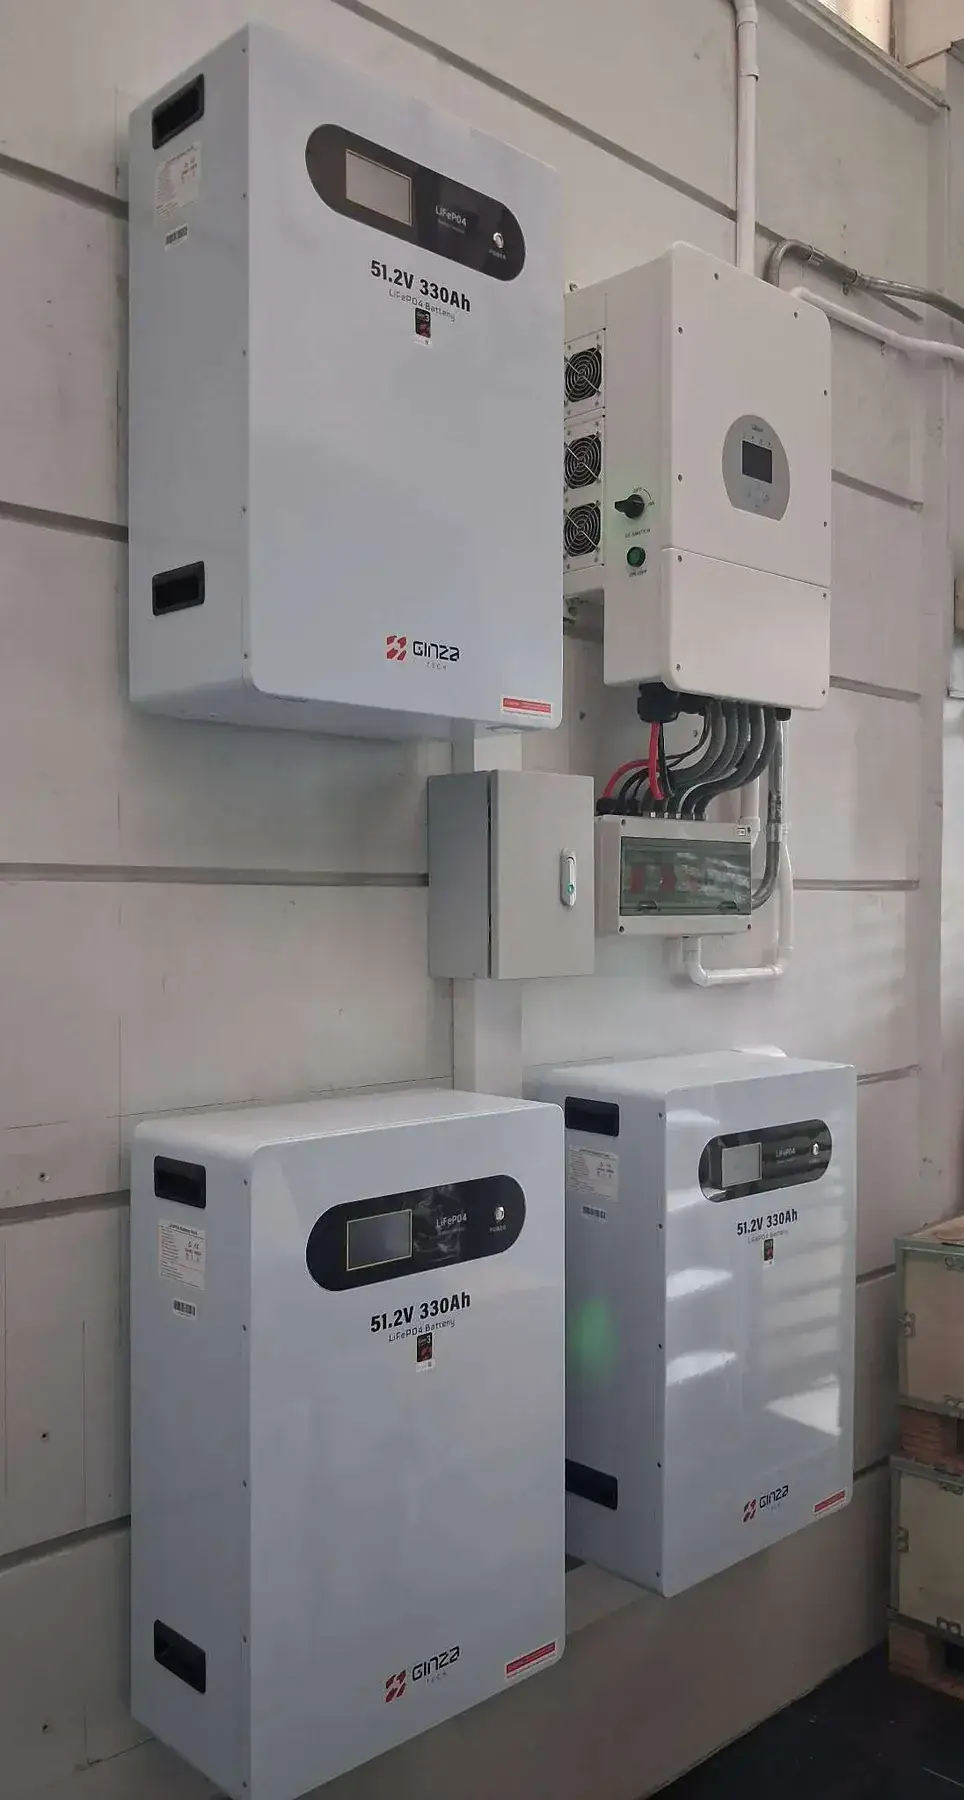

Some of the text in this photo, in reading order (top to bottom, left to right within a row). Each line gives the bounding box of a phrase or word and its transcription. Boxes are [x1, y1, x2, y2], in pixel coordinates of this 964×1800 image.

[435, 205, 467, 227] LiFePO4
[370, 259, 471, 313] 51.2V 330Ah
[425, 302, 456, 322] Battery
[436, 1213, 467, 1228] LiFePO4
[736, 1208, 798, 1236] 51.2V 330Ah
[370, 1291, 471, 1333] 51.2V 330Ah
[388, 1326, 423, 1342] LiFePO4
[425, 1318, 456, 1333] Battery
